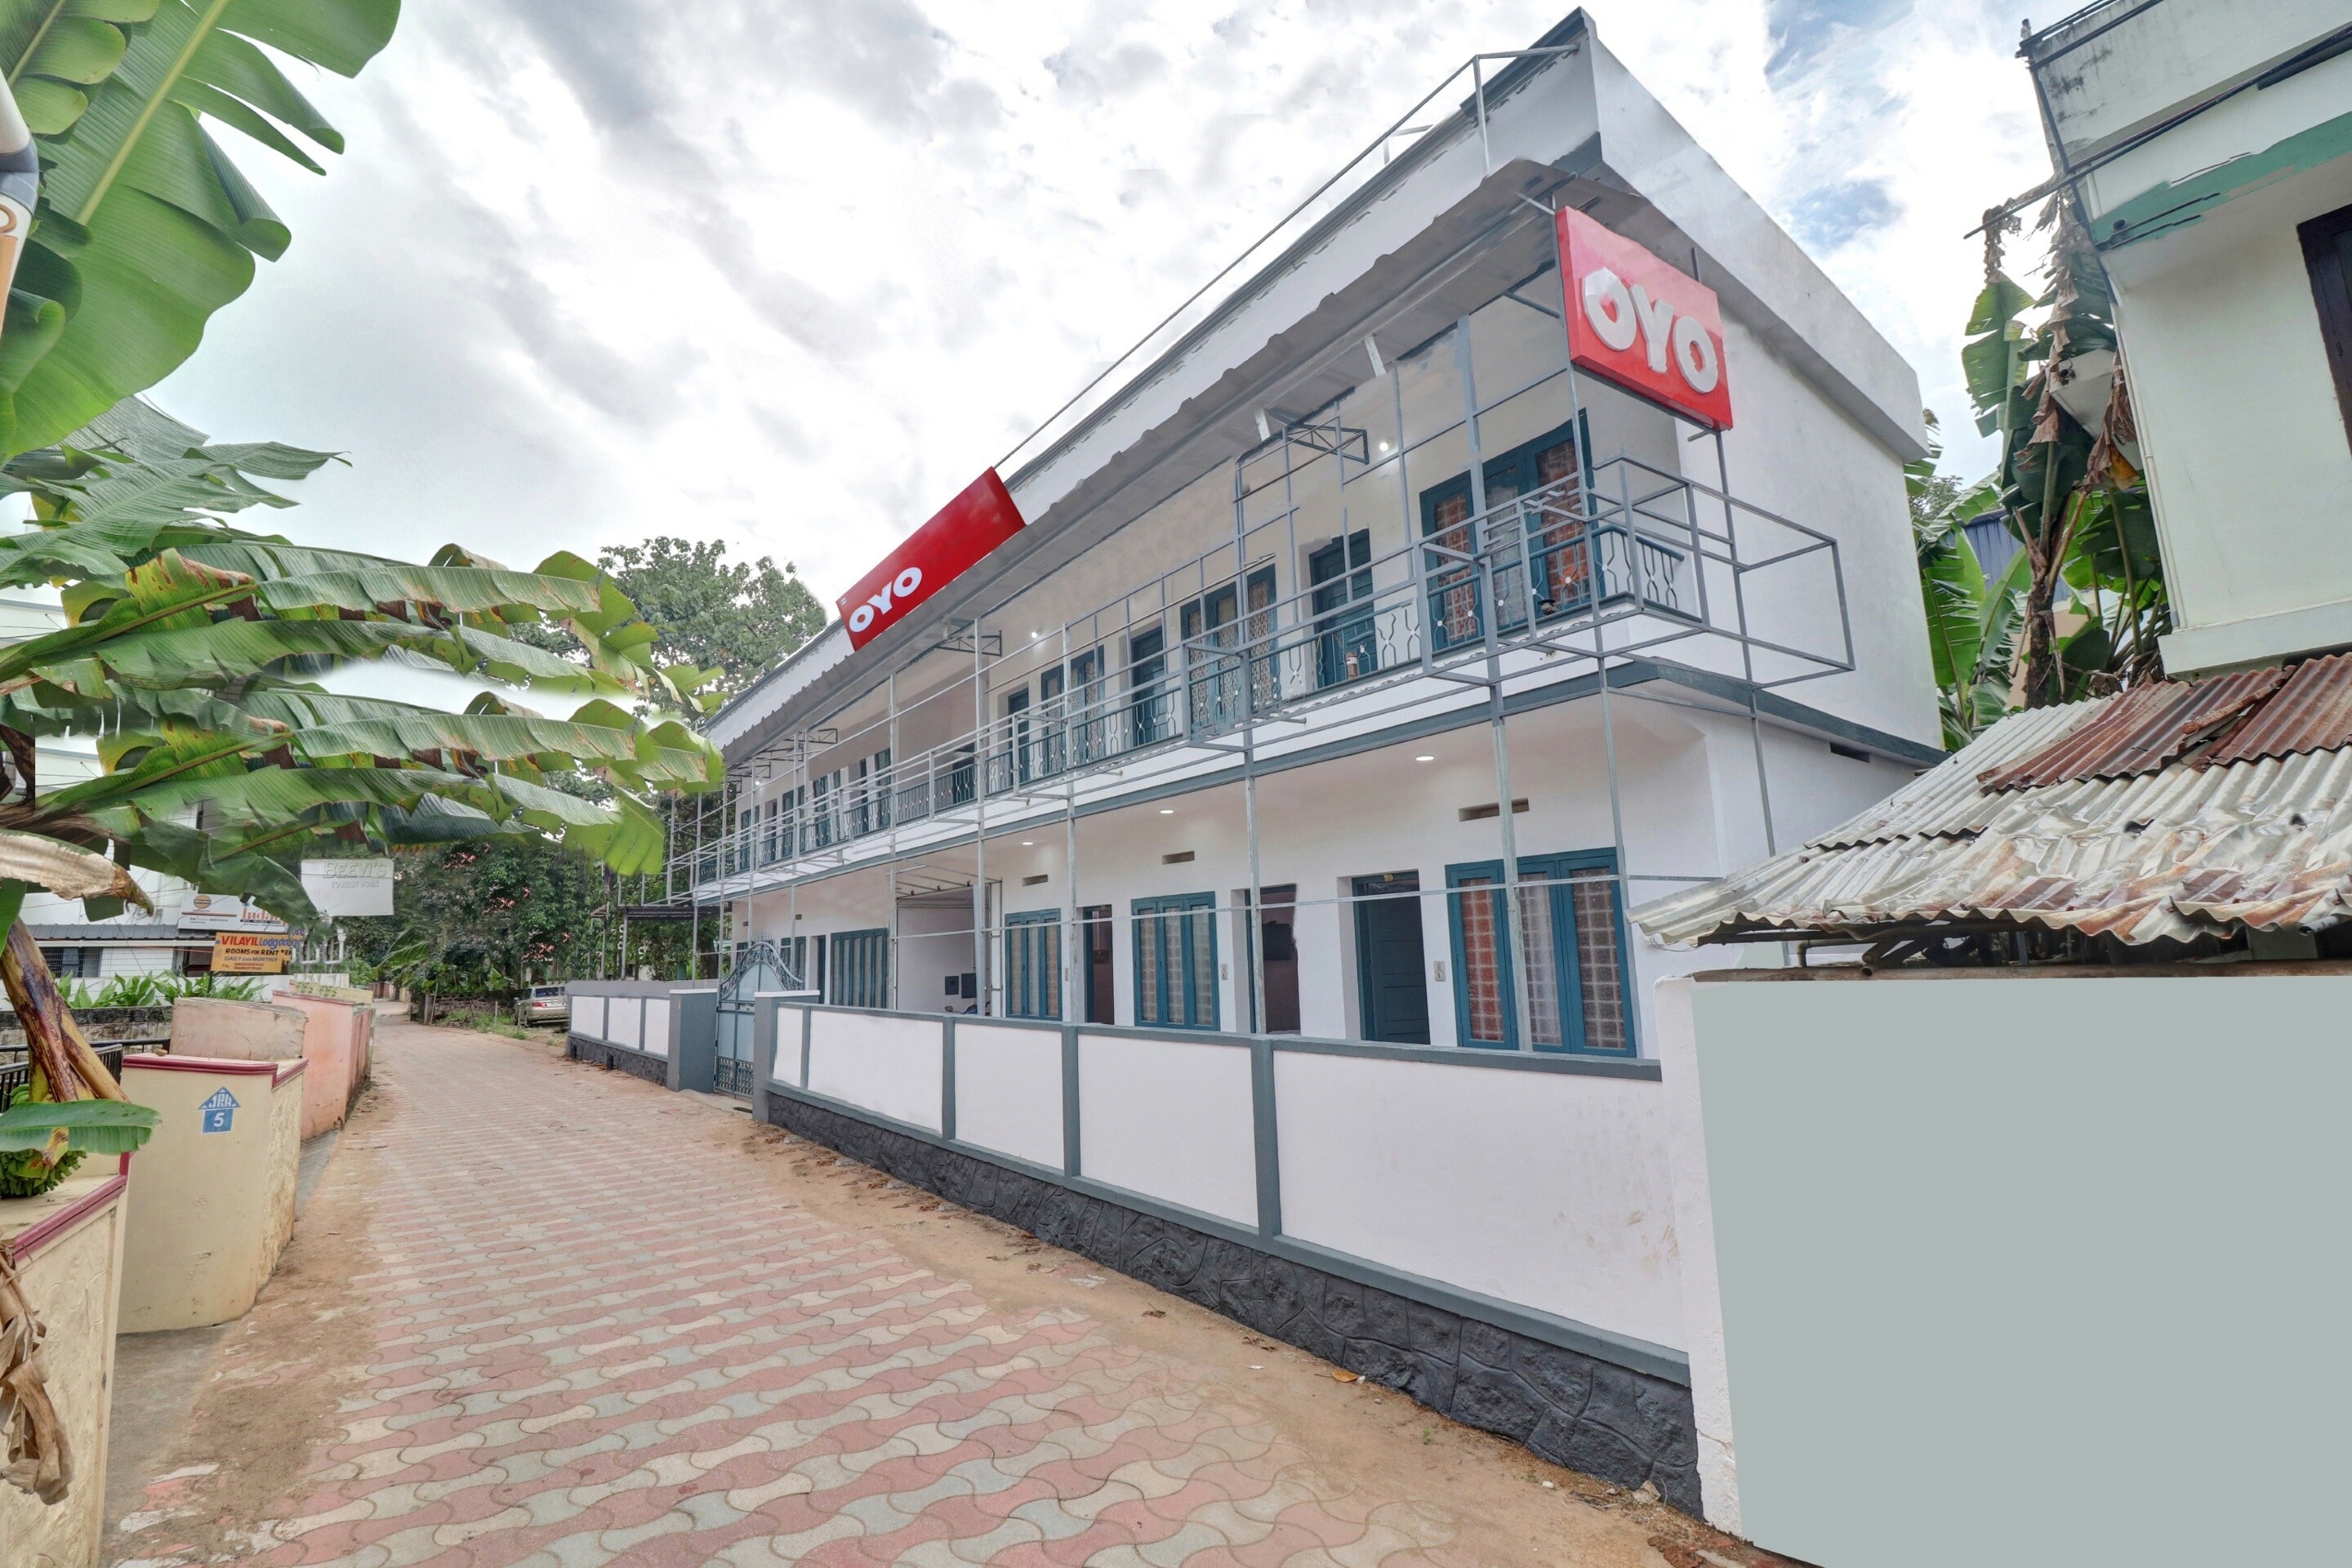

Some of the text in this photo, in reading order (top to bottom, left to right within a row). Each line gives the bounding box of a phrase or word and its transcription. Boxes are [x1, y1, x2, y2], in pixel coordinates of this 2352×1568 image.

[1582, 266, 1719, 394] OYO
[849, 567, 923, 633] OYO
[323, 862, 387, 878] BEEVI'S
[331, 880, 380, 889] TOURIST HOME
[221, 935, 260, 947] VILAYIL
[213, 1111, 225, 1128] 5
